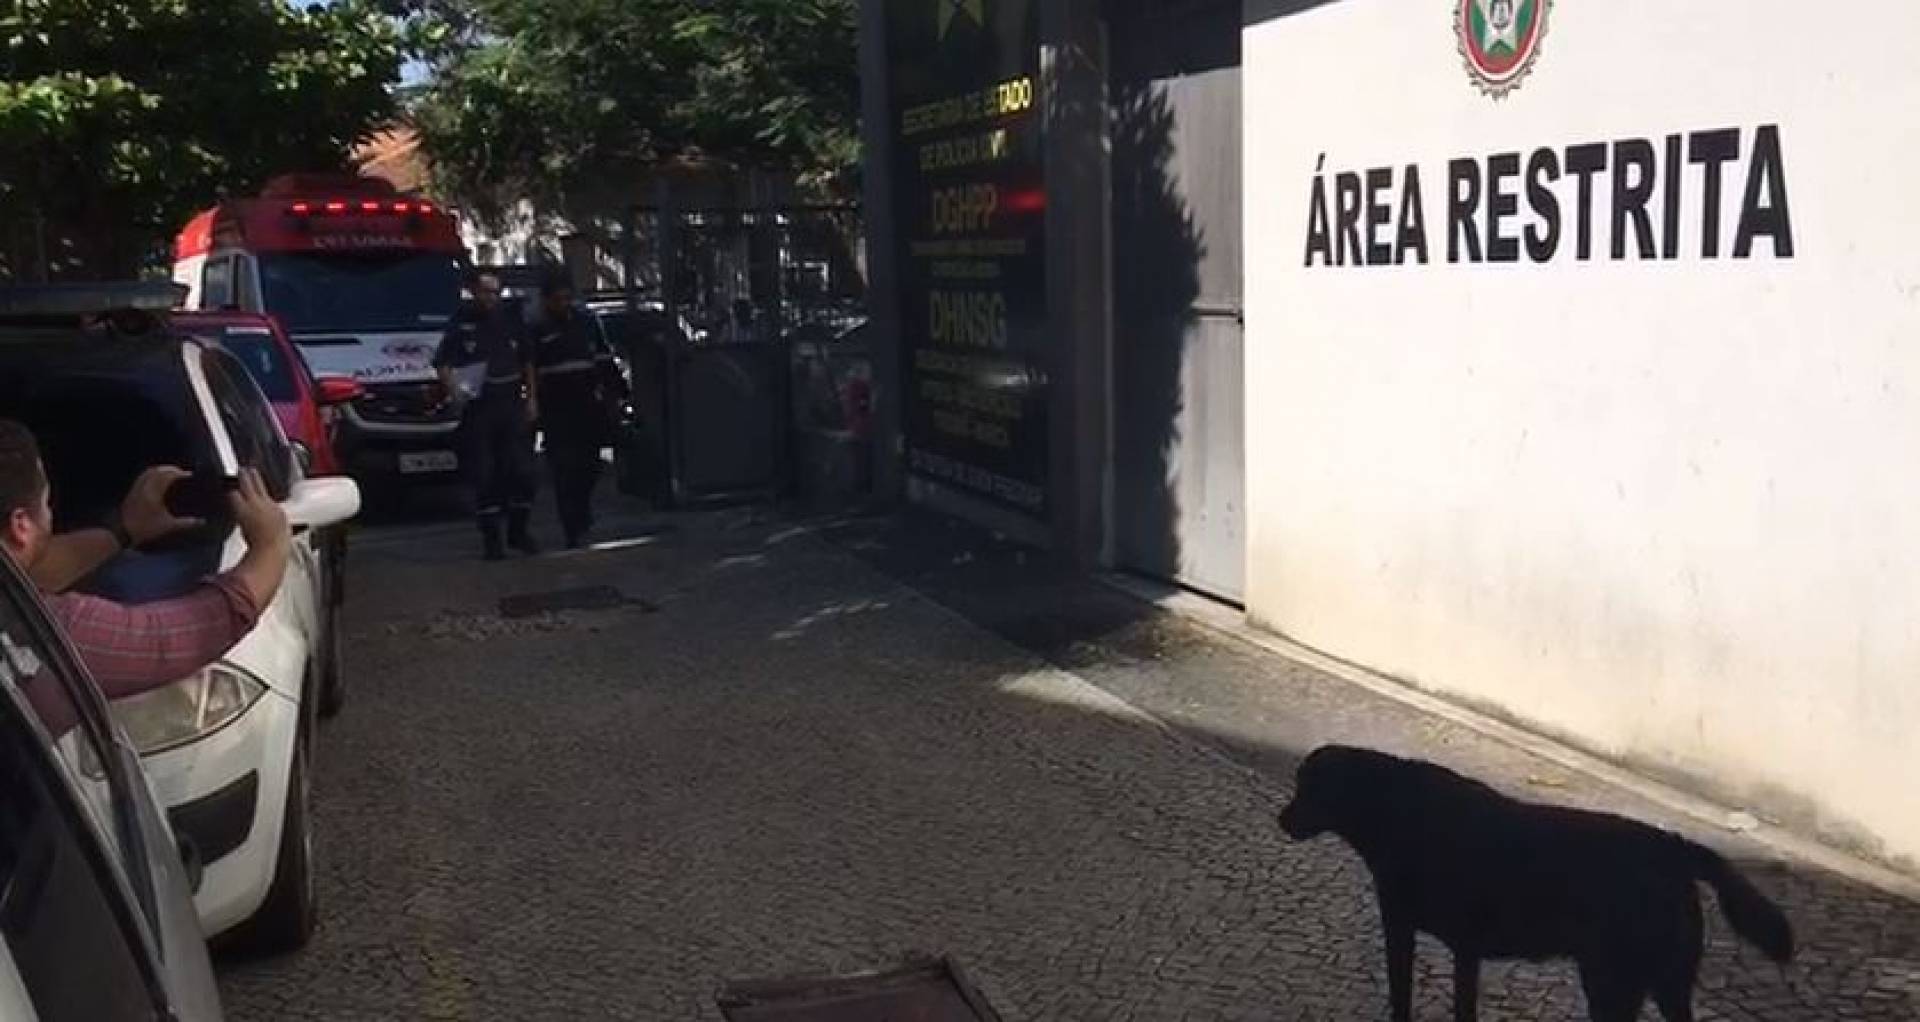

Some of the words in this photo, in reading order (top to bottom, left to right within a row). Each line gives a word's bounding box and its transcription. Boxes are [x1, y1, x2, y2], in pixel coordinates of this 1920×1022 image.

[1304, 152, 1429, 267] ÁREA
[1446, 124, 1795, 264] RESTRITA
[928, 290, 1008, 346] DHNSG
